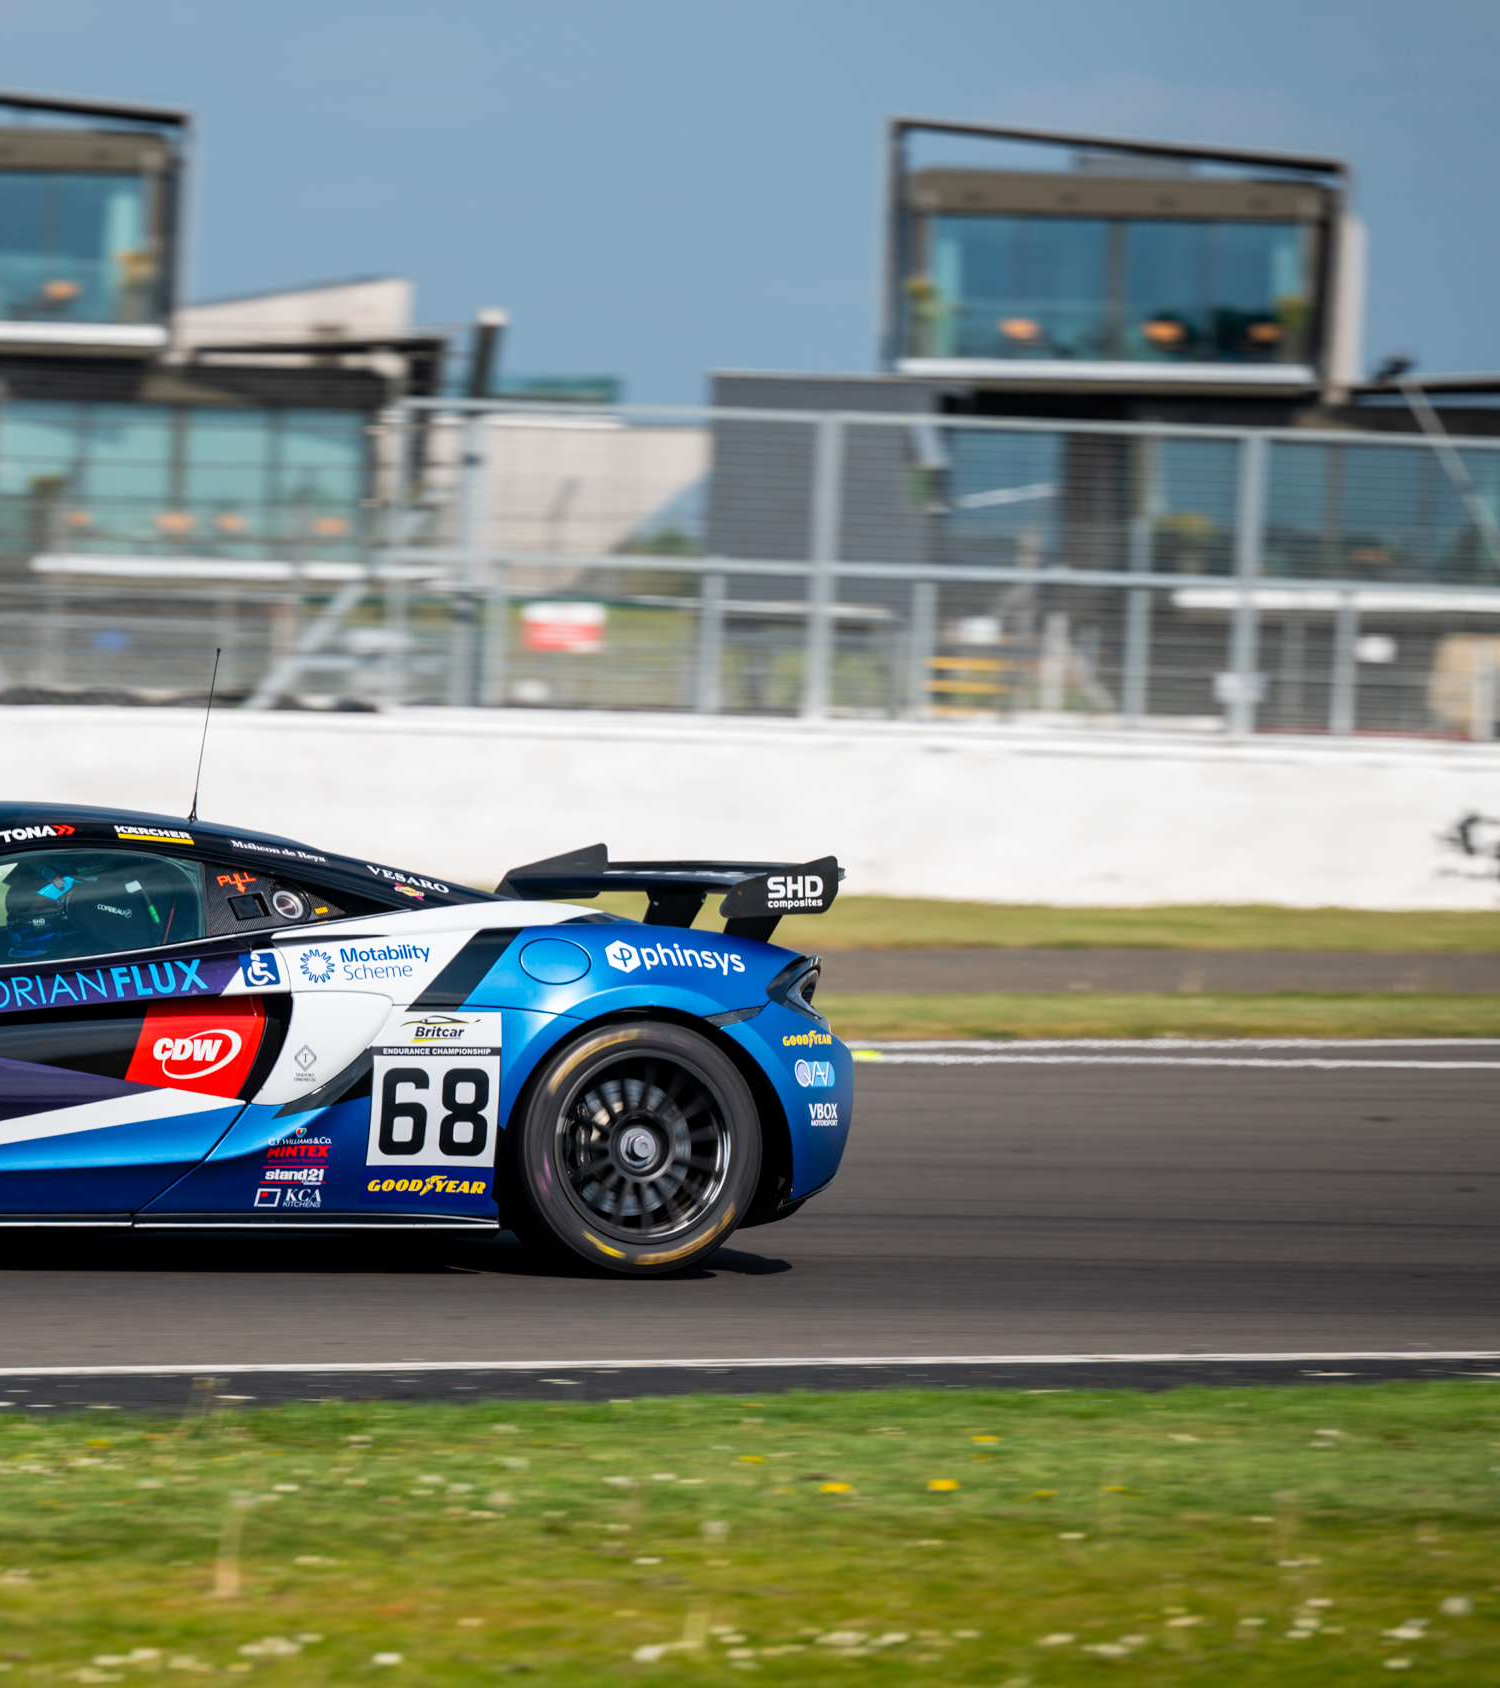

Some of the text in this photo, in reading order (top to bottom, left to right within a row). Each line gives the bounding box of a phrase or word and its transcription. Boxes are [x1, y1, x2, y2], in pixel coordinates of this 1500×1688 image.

[282, 849, 296, 857] de
[297, 851, 326, 863] Reya
[216, 872, 256, 886] PULL
[366, 865, 449, 894] VESARO
[767, 875, 824, 899] SHD
[767, 898, 823, 909] composites
[340, 944, 430, 963] Motability
[640, 943, 746, 976] phinsys
[343, 964, 413, 981] Scheme
[414, 1026, 465, 1038] Britcar
[152, 1037, 223, 1062] CDW
[432, 1048, 491, 1056] CHAMPIONSHIP
[378, 1067, 490, 1157] 68
[808, 1103, 838, 1119] VBOX
[266, 1145, 329, 1158] MINTEX
[367, 1175, 487, 1196] GOODYEAR
[285, 1188, 322, 1202] KCA
[282, 1200, 321, 1208] KITCHENS
